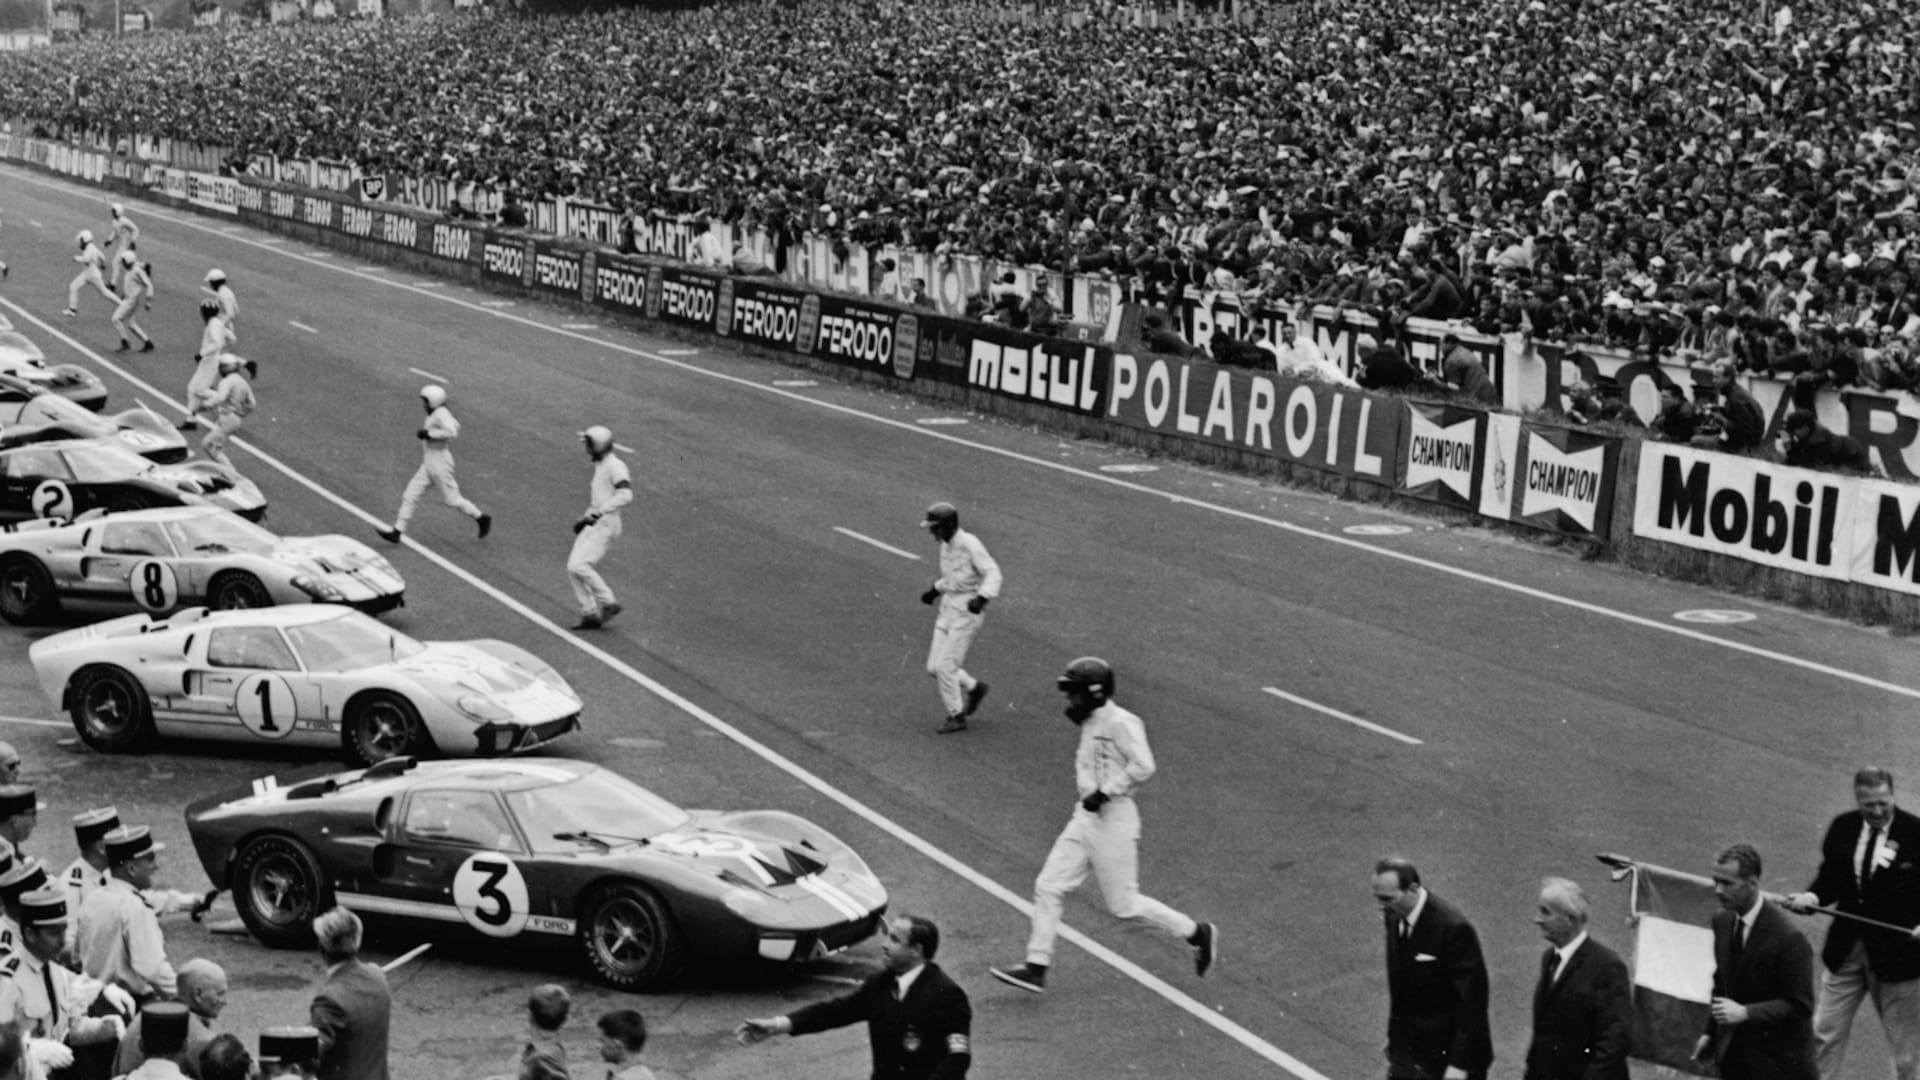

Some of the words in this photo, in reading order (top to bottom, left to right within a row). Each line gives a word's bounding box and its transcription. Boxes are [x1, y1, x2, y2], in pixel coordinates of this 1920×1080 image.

[365, 180, 384, 198] BP
[342, 205, 372, 237] FERODO
[384, 213, 417, 247] FERODO
[433, 224, 470, 260] FERODO
[567, 203, 622, 246] MARTIN
[484, 243, 524, 278] FERODO
[536, 254, 580, 291] FERODO
[597, 267, 646, 308] FERODO
[660, 280, 715, 322] FERODO
[1093, 293, 1110, 324] BP
[733, 297, 798, 343] FERODO
[818, 315, 892, 365] FERODO
[968, 338, 1099, 411] motul
[1110, 354, 1384, 476] POLAROIL
[1411, 435, 1472, 473] CHAMPION
[1528, 459, 1598, 503] CHAMPION
[43, 485, 64, 522] 2
[1657, 454, 1839, 567] Mobil
[1872, 493, 1920, 587] M
[144, 562, 165, 609] 8
[254, 679, 280, 733] 1
[472, 860, 512, 926] 3
[533, 918, 570, 932] FORD
